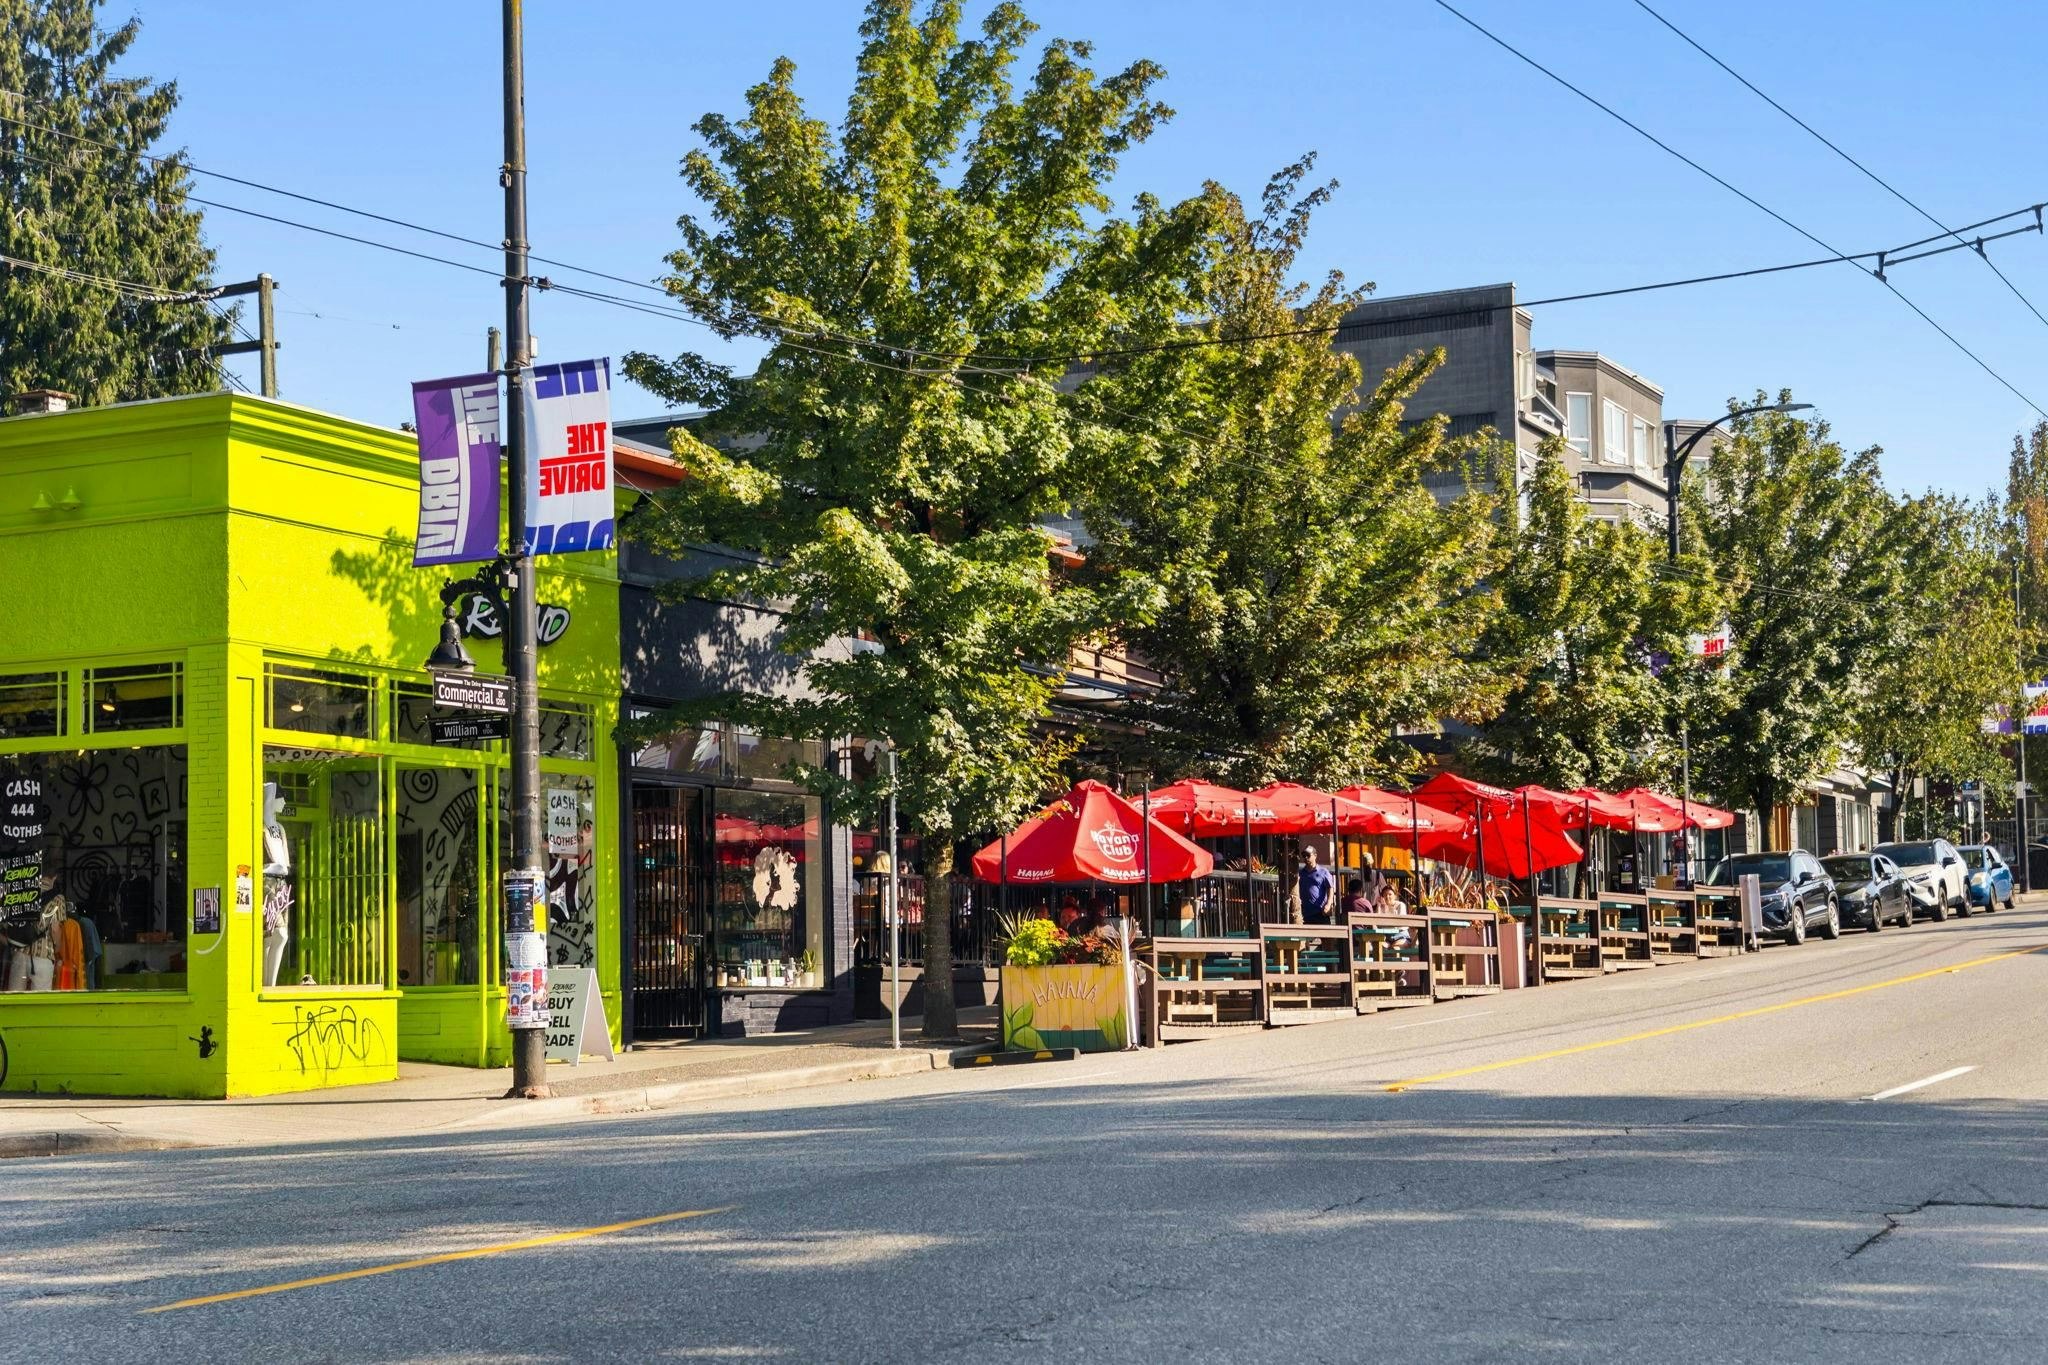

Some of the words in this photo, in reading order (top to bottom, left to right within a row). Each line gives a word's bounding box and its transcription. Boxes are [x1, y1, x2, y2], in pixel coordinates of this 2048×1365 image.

[438, 684, 494, 705] Commercial
[444, 724, 478, 737] William
[6, 779, 41, 797] CASH
[11, 803, 35, 816] 444
[551, 795, 576, 810] CASH
[3, 823, 42, 838] CLOTHES
[1090, 829, 1140, 845] Havana
[1103, 844, 1133, 857] Club
[1017, 868, 1055, 878] HAVANA
[1102, 866, 1146, 879] HAVANA
[1032, 978, 1098, 1008] HAVANA
[548, 997, 575, 1010] BUY
